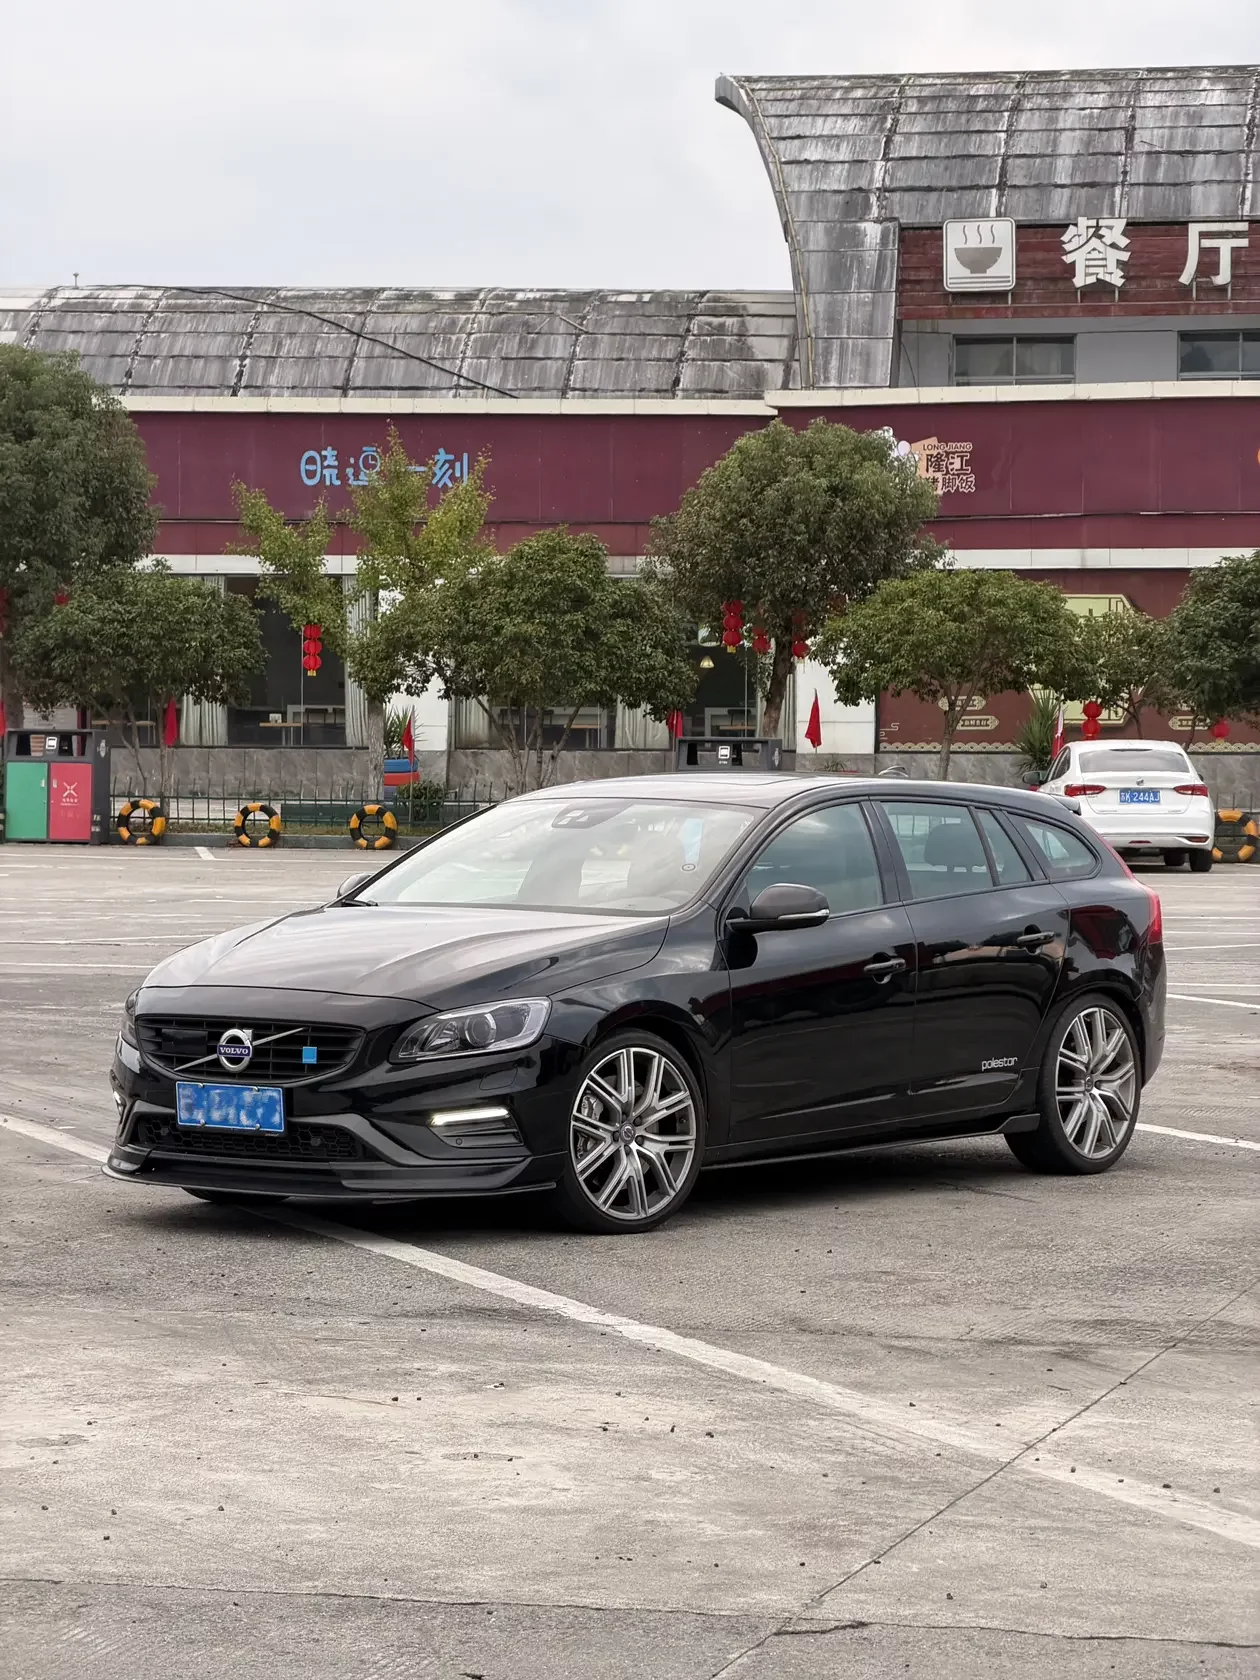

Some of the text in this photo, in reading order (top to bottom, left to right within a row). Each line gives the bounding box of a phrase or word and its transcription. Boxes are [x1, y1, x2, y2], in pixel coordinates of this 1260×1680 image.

[1060, 216, 1249, 288] 餐厅
[922, 442, 973, 451] LONG JIANG
[925, 452, 972, 474] 隆江
[219, 1046, 249, 1055] VOLVO
[981, 1056, 1018, 1072] polestar
